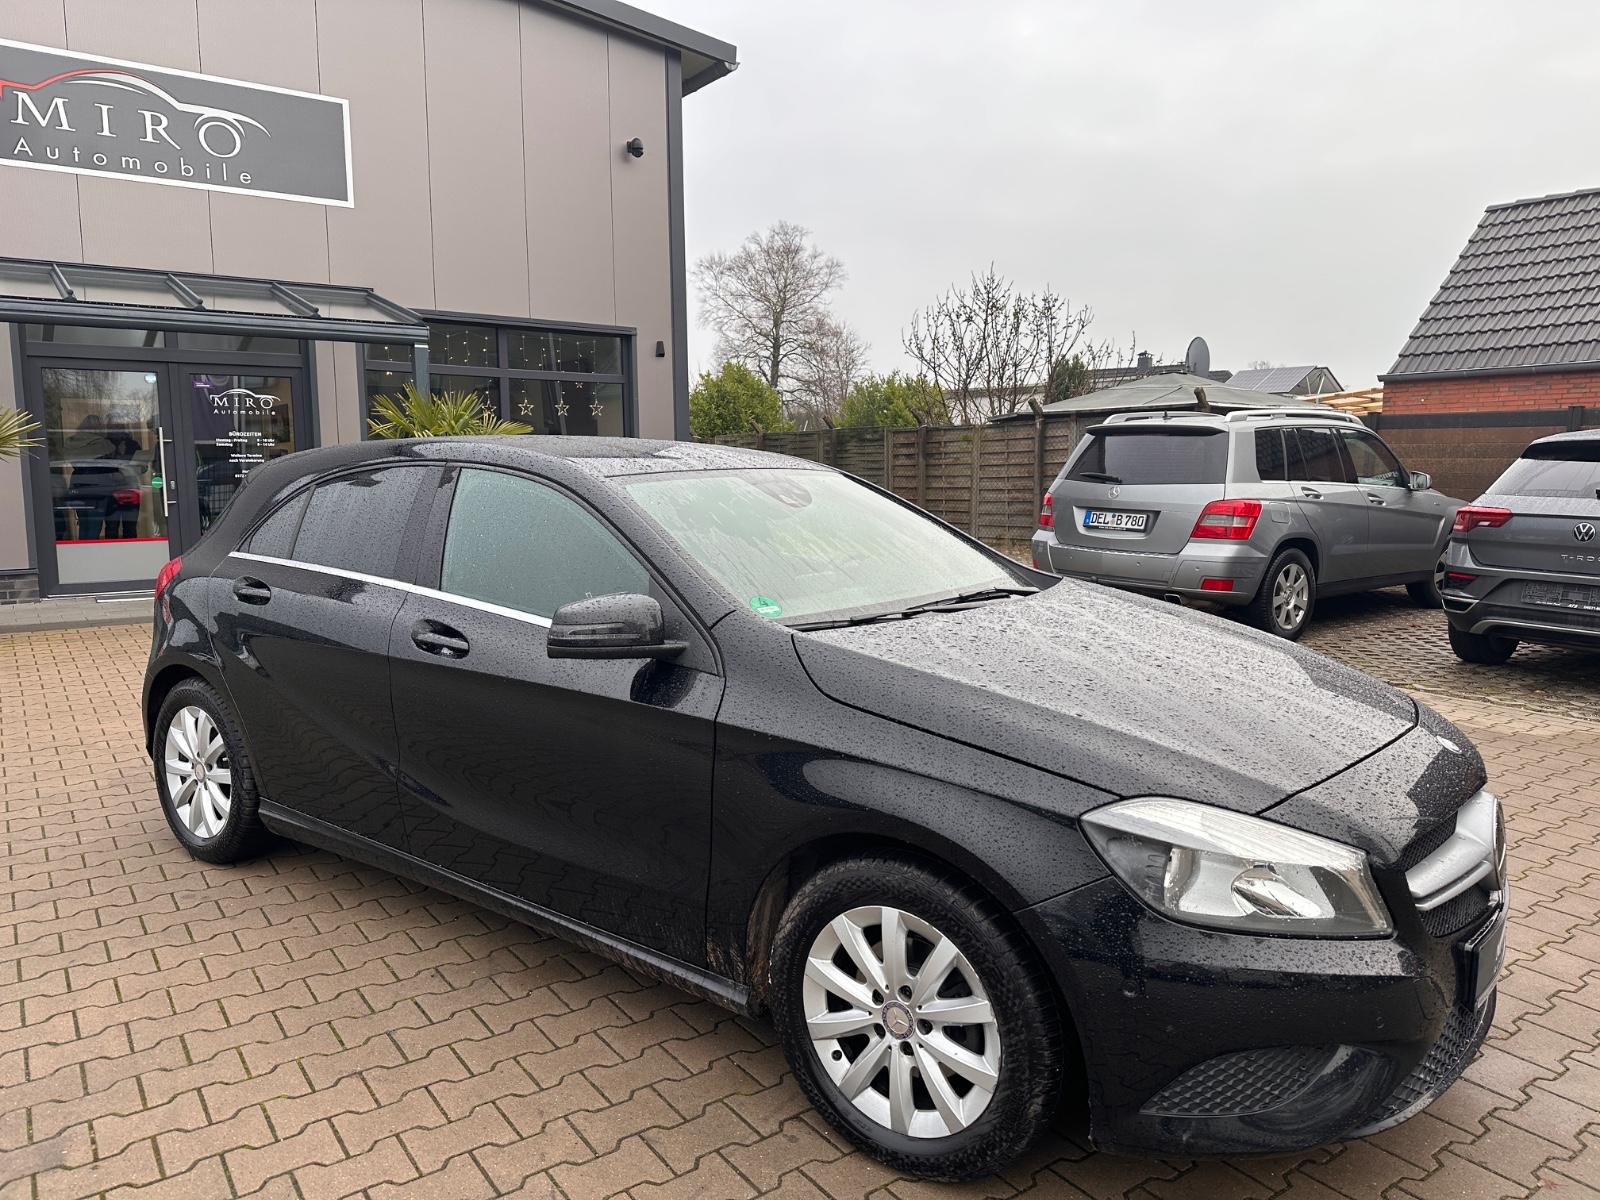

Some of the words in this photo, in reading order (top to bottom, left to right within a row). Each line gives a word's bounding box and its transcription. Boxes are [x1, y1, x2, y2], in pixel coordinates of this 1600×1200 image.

[10, 90, 242, 158] MIRO
[13, 136, 252, 184] Automobile
[213, 397, 273, 409] MIRO
[1090, 512, 1109, 525] DEL
[1115, 514, 1123, 526] B
[1125, 515, 1145, 527] 780
